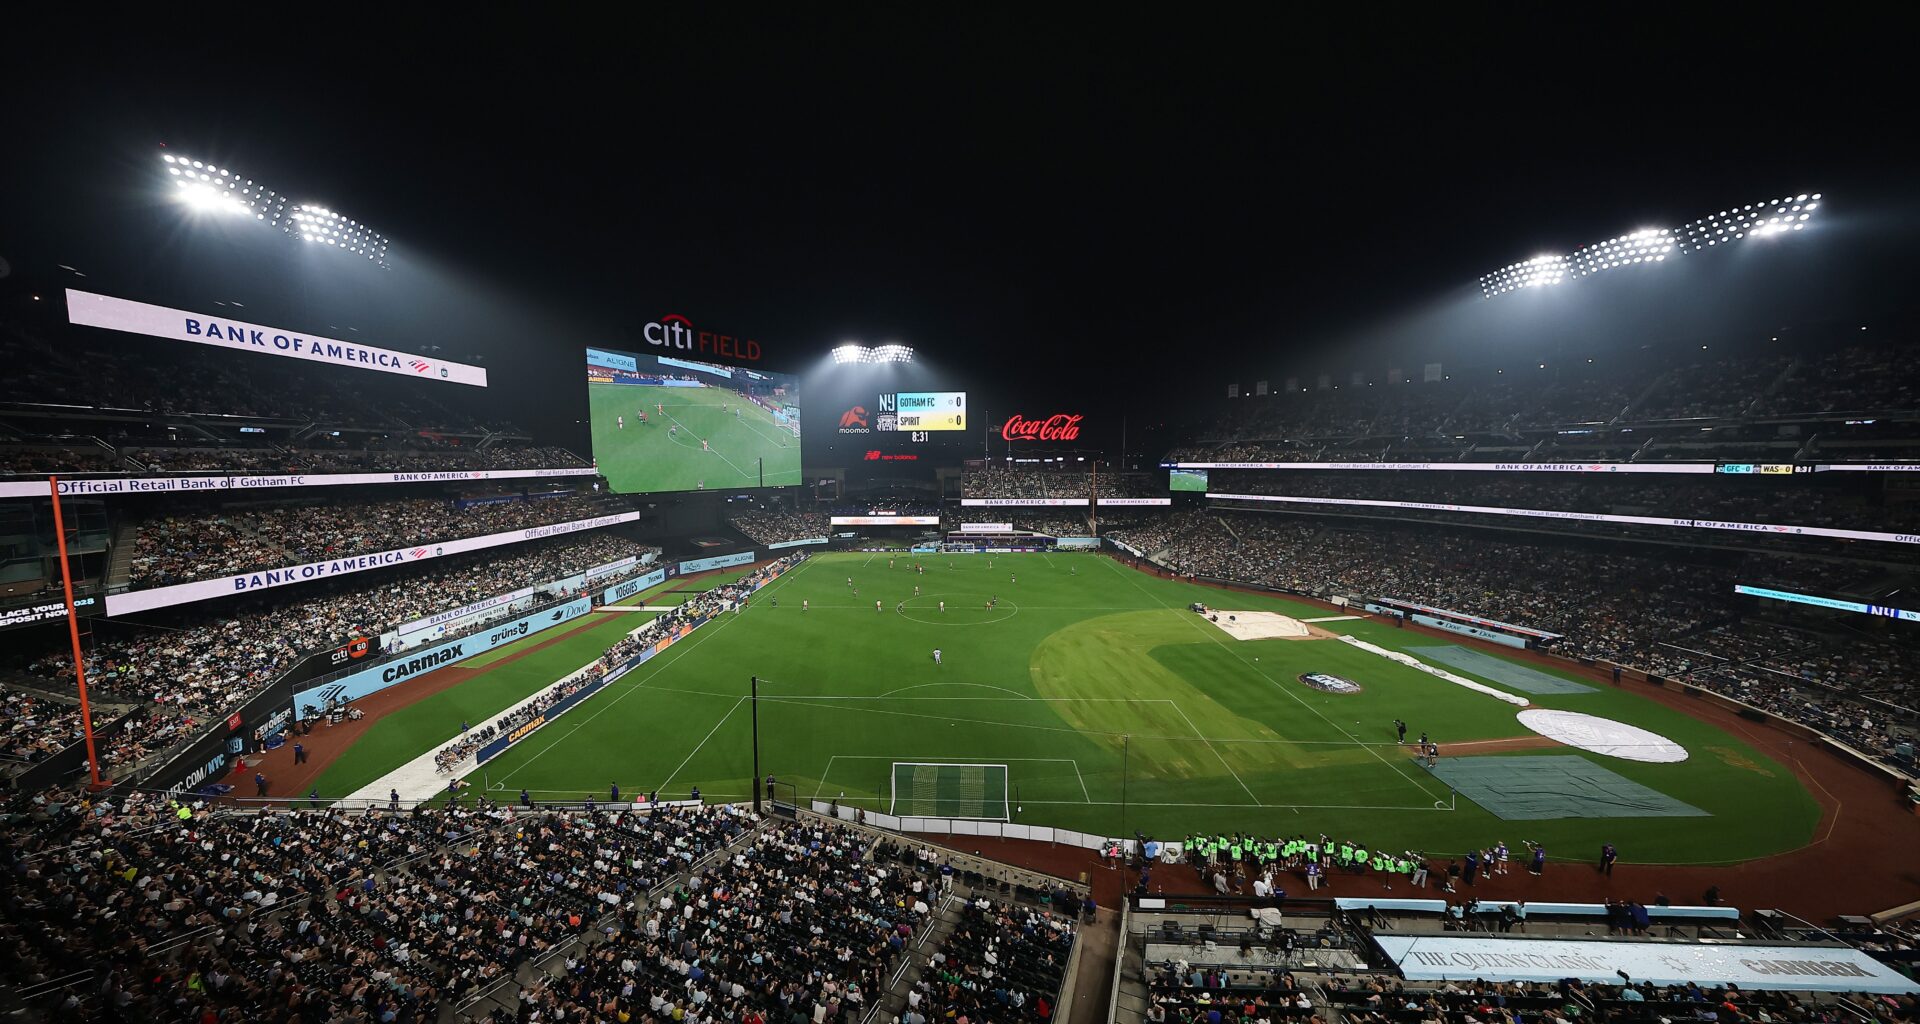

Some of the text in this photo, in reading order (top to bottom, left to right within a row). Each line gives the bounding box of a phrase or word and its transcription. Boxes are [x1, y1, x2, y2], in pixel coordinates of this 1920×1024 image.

[185, 318, 401, 369] BANK OF AMERICA
[643, 317, 761, 361] citi FIELD
[607, 357, 635, 368] ALIGNE
[900, 398, 936, 407] GOTHAM FC
[956, 397, 961, 407] 0
[900, 416, 920, 426] SPIRIT
[956, 415, 961, 426] 0
[911, 431, 929, 442] 8:31
[394, 473, 420, 481] BANK
[434, 472, 469, 480] AMERICA
[57, 476, 305, 494] Official Retail Bank of Gotham FC
[524, 515, 621, 539] Official Retail Bank of Gotham FC
[1673, 519, 1702, 527] BANK
[1719, 522, 1768, 531] AMERICA
[234, 551, 404, 591] BANK OF AMERICA
[615, 581, 638, 599] YOGGIES
[73, 598, 95, 607] 028
[0, 603, 65, 620] LACE YOUR
[430, 599, 497, 624] BANK OF AMERICA
[567, 602, 588, 619] Dove
[0, 609, 70, 626] EPOSIT NOW
[1445, 622, 1461, 631] Dove
[491, 625, 518, 645] grüns
[1479, 630, 1497, 639] Dove
[357, 642, 367, 651] 60
[331, 649, 348, 661] citi
[1408, 951, 1453, 967] THE
[1525, 953, 1614, 971] CLASSIC
